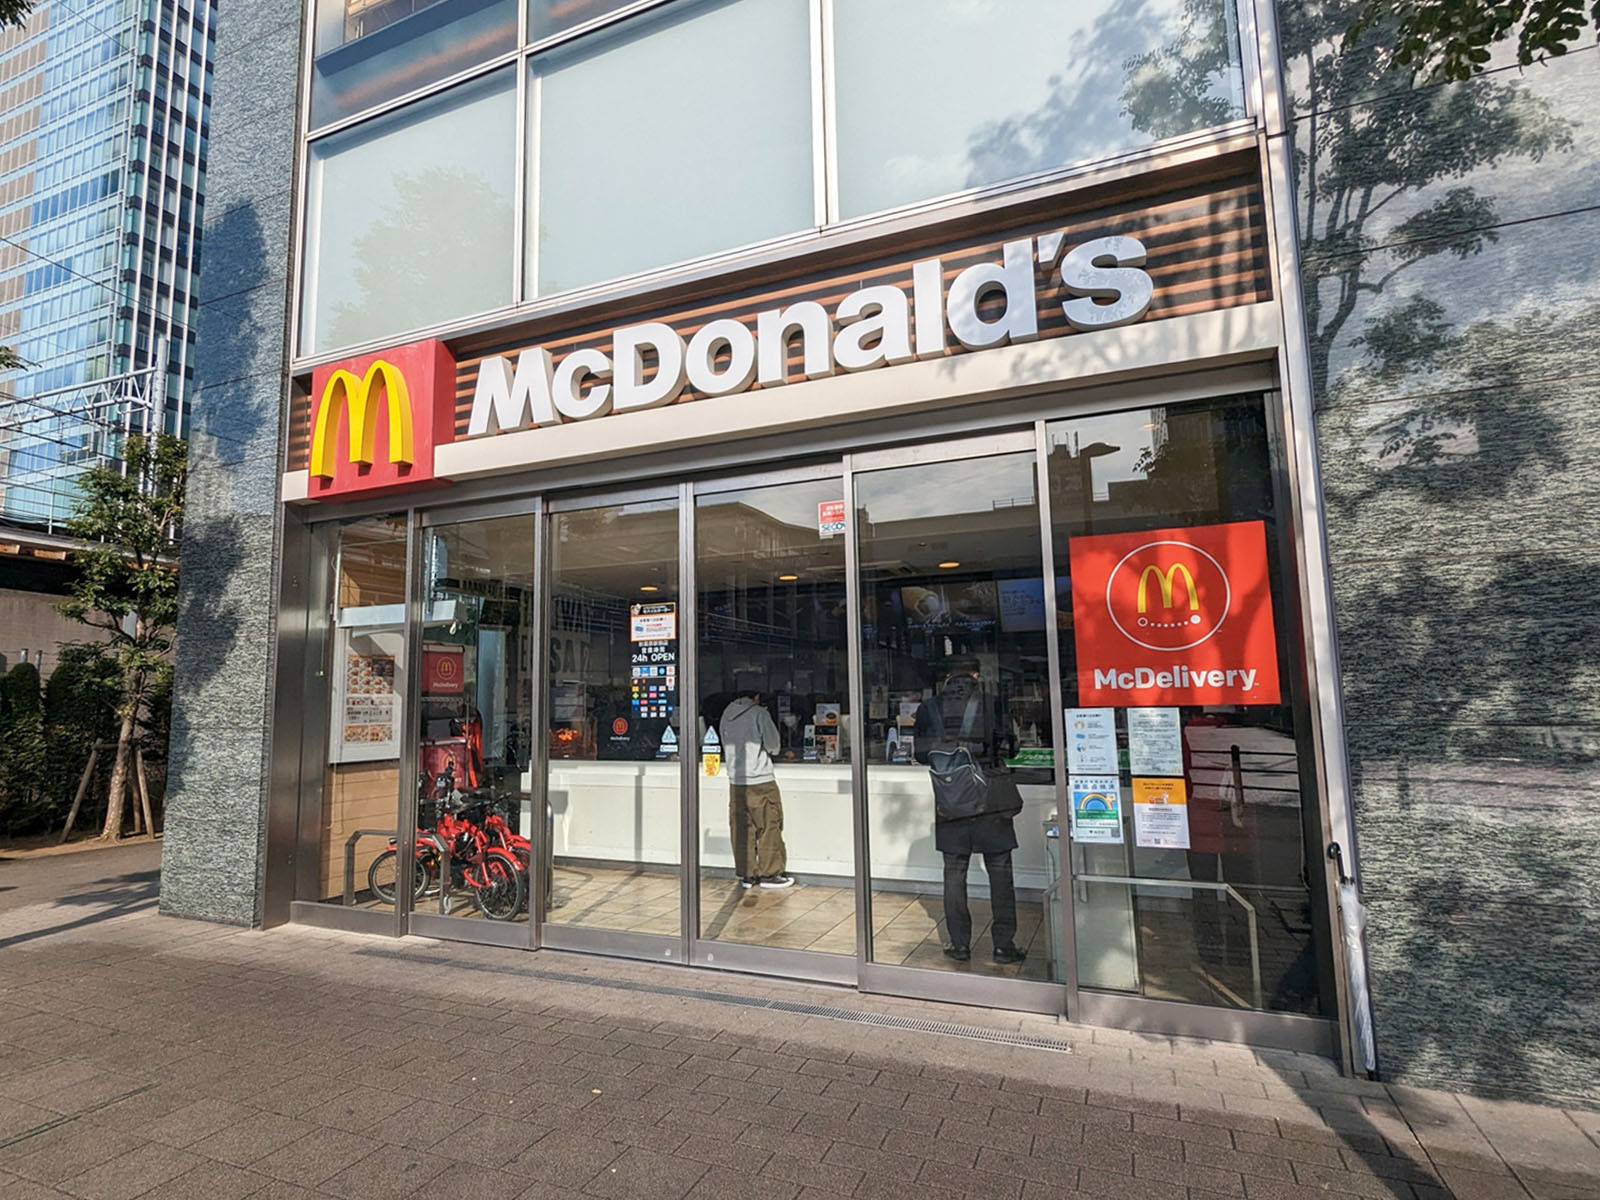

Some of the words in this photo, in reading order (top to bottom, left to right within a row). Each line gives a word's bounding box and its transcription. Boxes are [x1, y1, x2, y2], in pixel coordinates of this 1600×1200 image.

[467, 231, 1153, 437] McDonald's
[632, 654, 647, 662] 24h
[651, 652, 675, 661] OPEN
[1094, 665, 1257, 691] McDelivery
